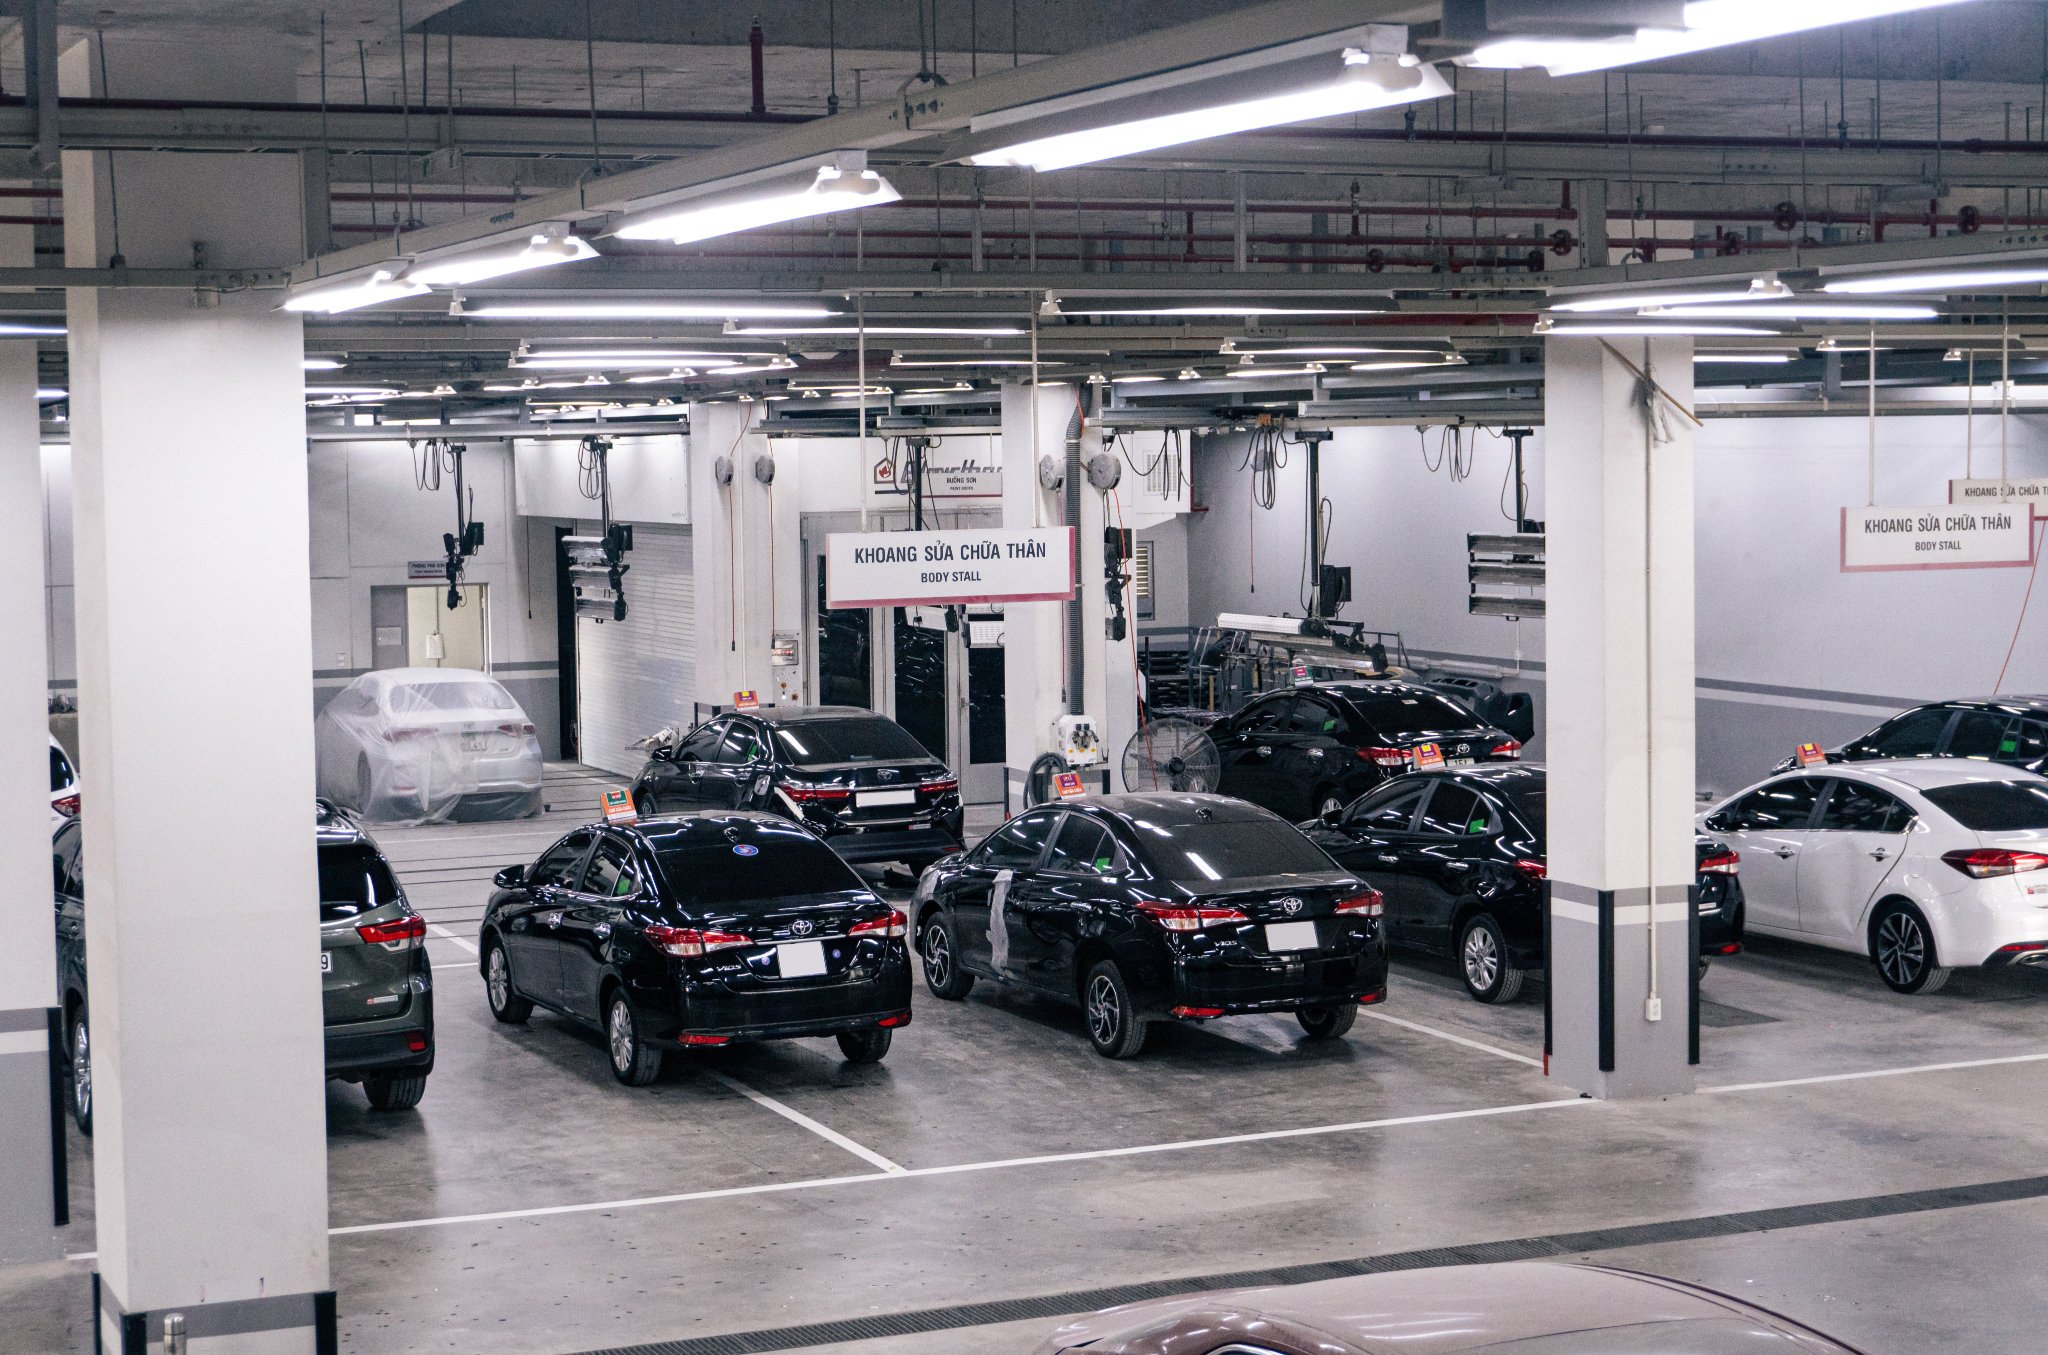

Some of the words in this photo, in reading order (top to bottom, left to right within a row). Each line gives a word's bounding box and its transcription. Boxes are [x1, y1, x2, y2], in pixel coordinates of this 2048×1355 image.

[1964, 487, 1997, 497] KHOANG
[1865, 518, 1913, 533] KHOANG
[1918, 513, 1941, 532] SỬA
[1945, 513, 1976, 531] CHỮA
[1981, 512, 2011, 530] THÂN
[855, 546, 917, 564] KHOANG
[924, 540, 954, 562] SỬA
[960, 540, 1001, 560] CHỮA
[1006, 538, 1046, 559] THÂN
[1915, 541, 1937, 551] BODY
[1938, 540, 1962, 550] STALL
[921, 571, 949, 583] BODY
[952, 570, 982, 582] STALL
